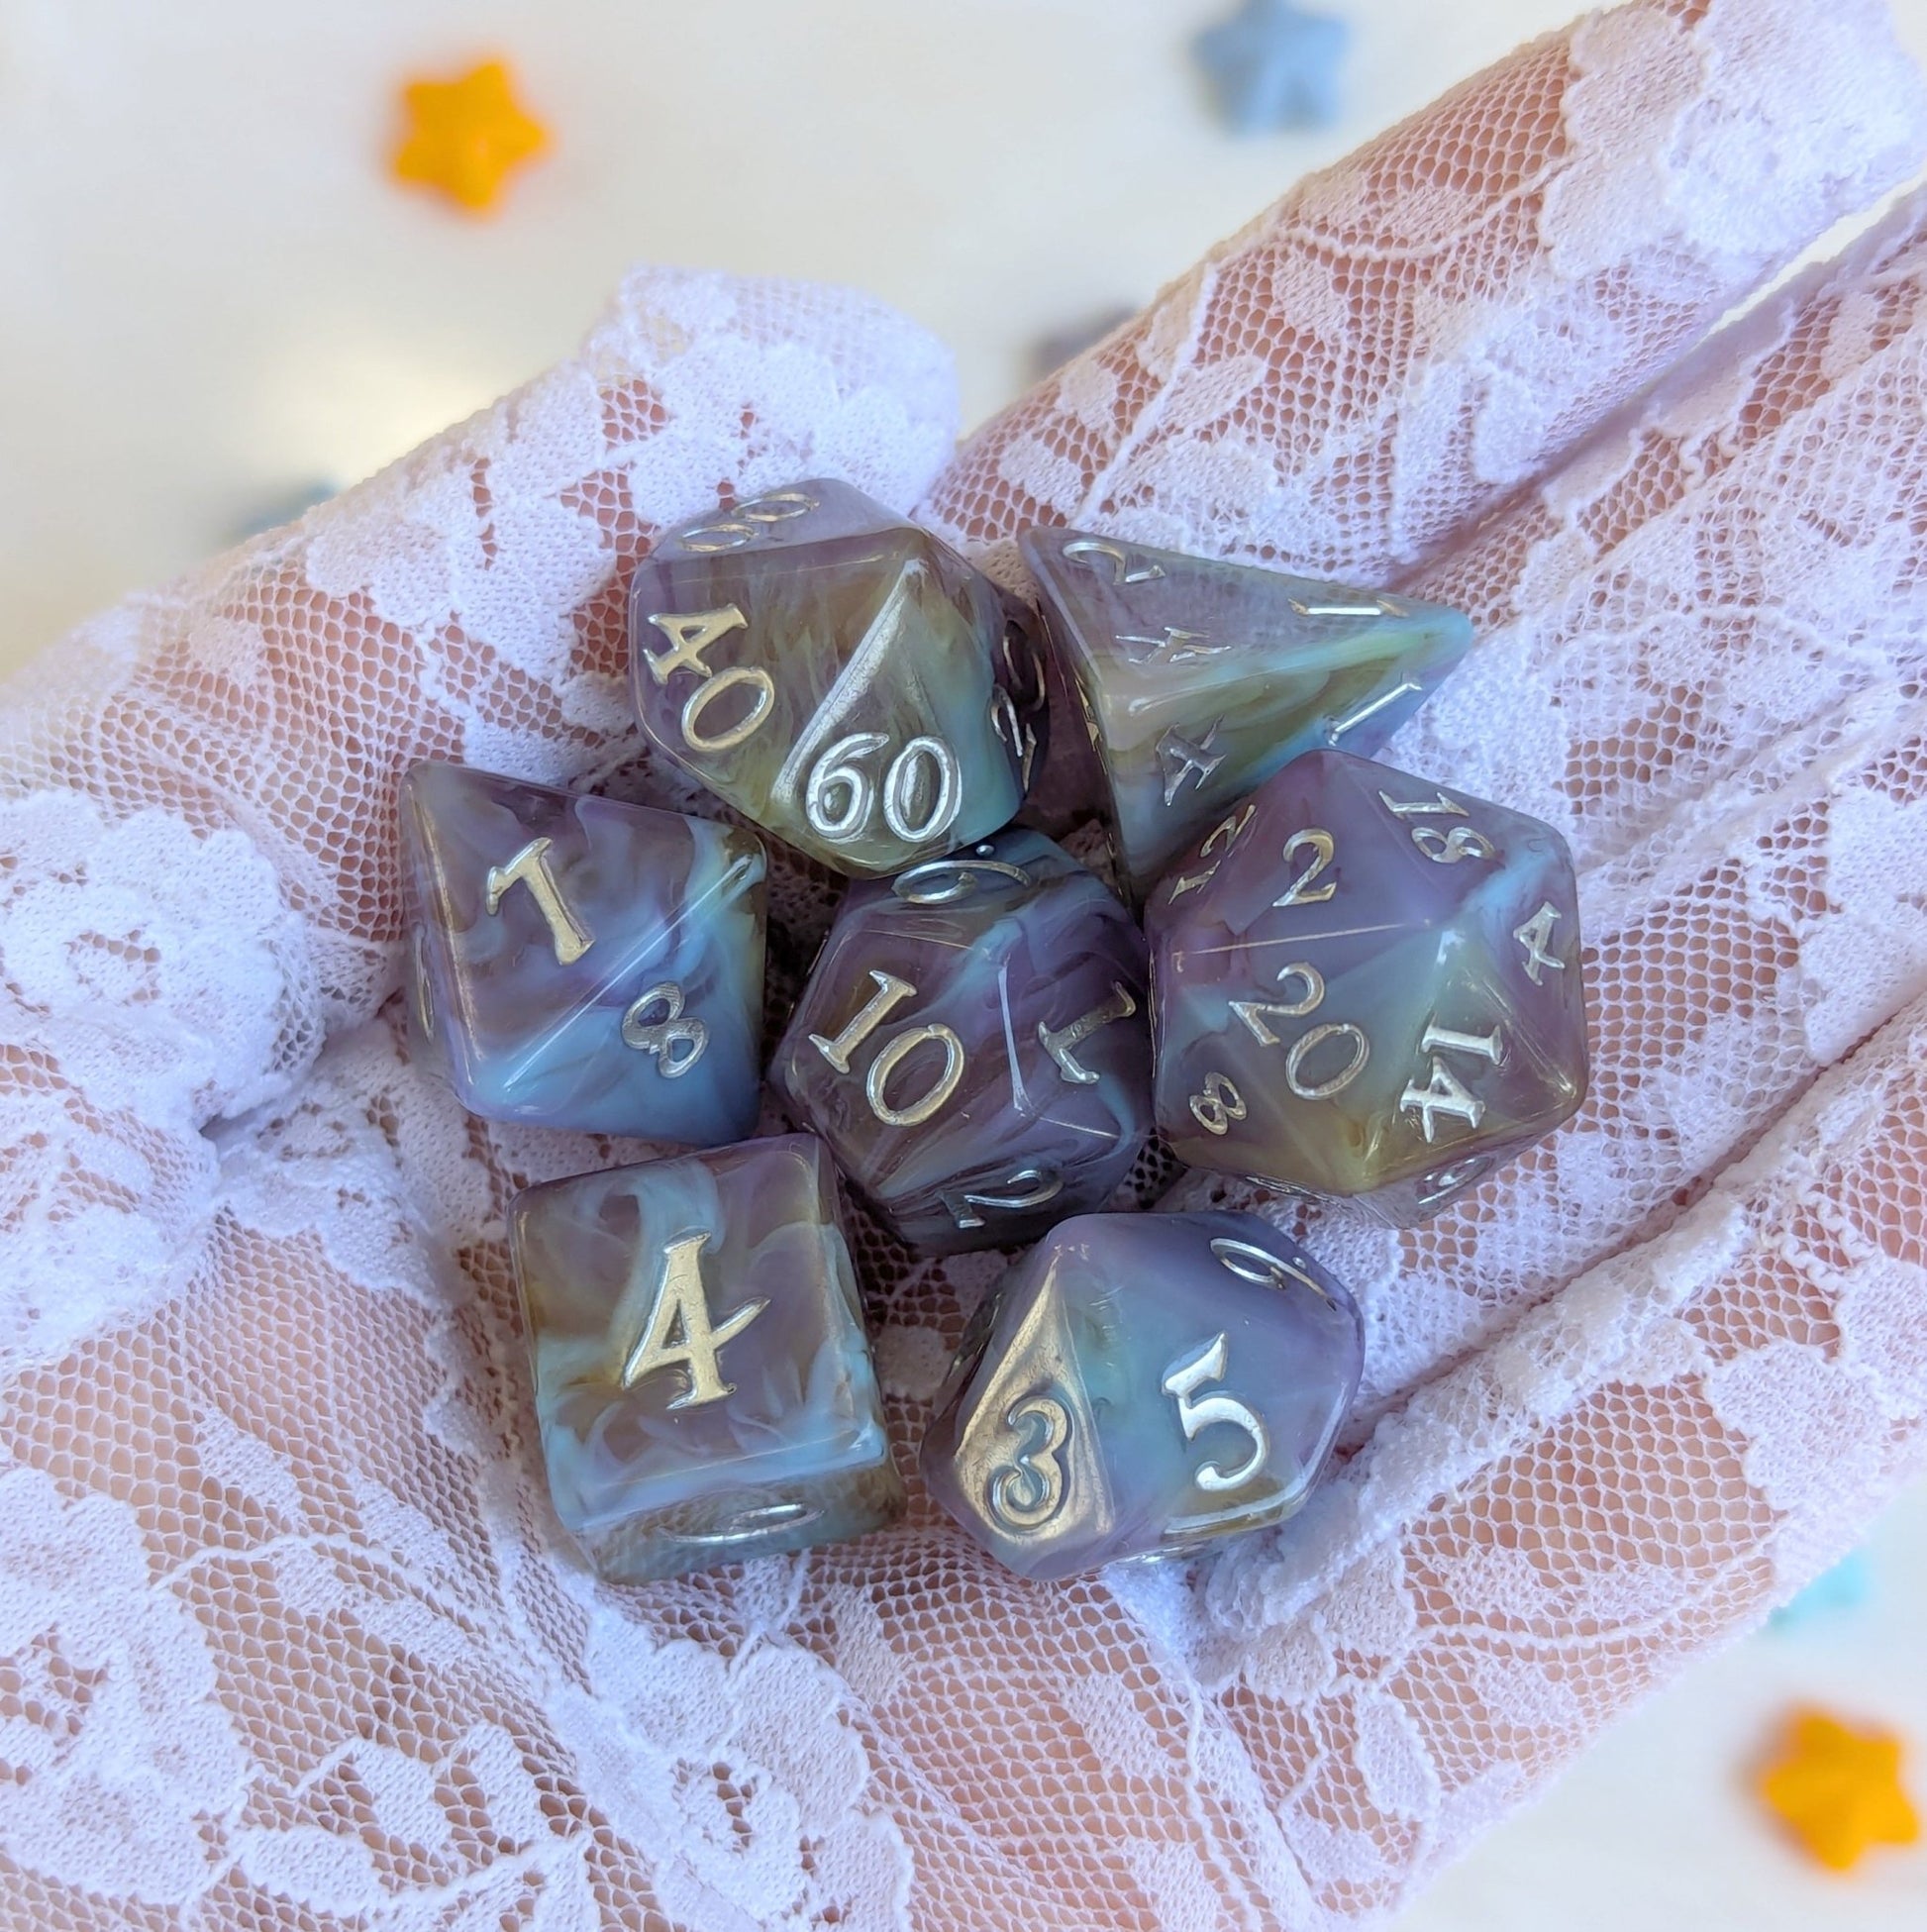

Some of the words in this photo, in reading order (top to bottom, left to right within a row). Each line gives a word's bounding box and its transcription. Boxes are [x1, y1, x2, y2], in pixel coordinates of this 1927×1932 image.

[1063, 542, 1166, 586] 2
[643, 603, 774, 752] 40
[805, 732, 962, 844] 60
[1155, 715, 1228, 807] 4
[1168, 803, 1257, 905] 12
[1272, 828, 1338, 908] 2
[1378, 789, 1498, 865] 18
[485, 836, 595, 966] 7
[1512, 901, 1567, 986] 4
[621, 980, 711, 1079] 8
[808, 968, 965, 1128] 10
[1228, 962, 1370, 1101] 20
[1399, 1013, 1504, 1144] 14
[1189, 1071, 1248, 1136] 8
[937, 1168, 1065, 1229] 2
[620, 1226, 771, 1411] 4
[988, 1390, 1073, 1533] 3
[1161, 1329, 1271, 1491] 5
